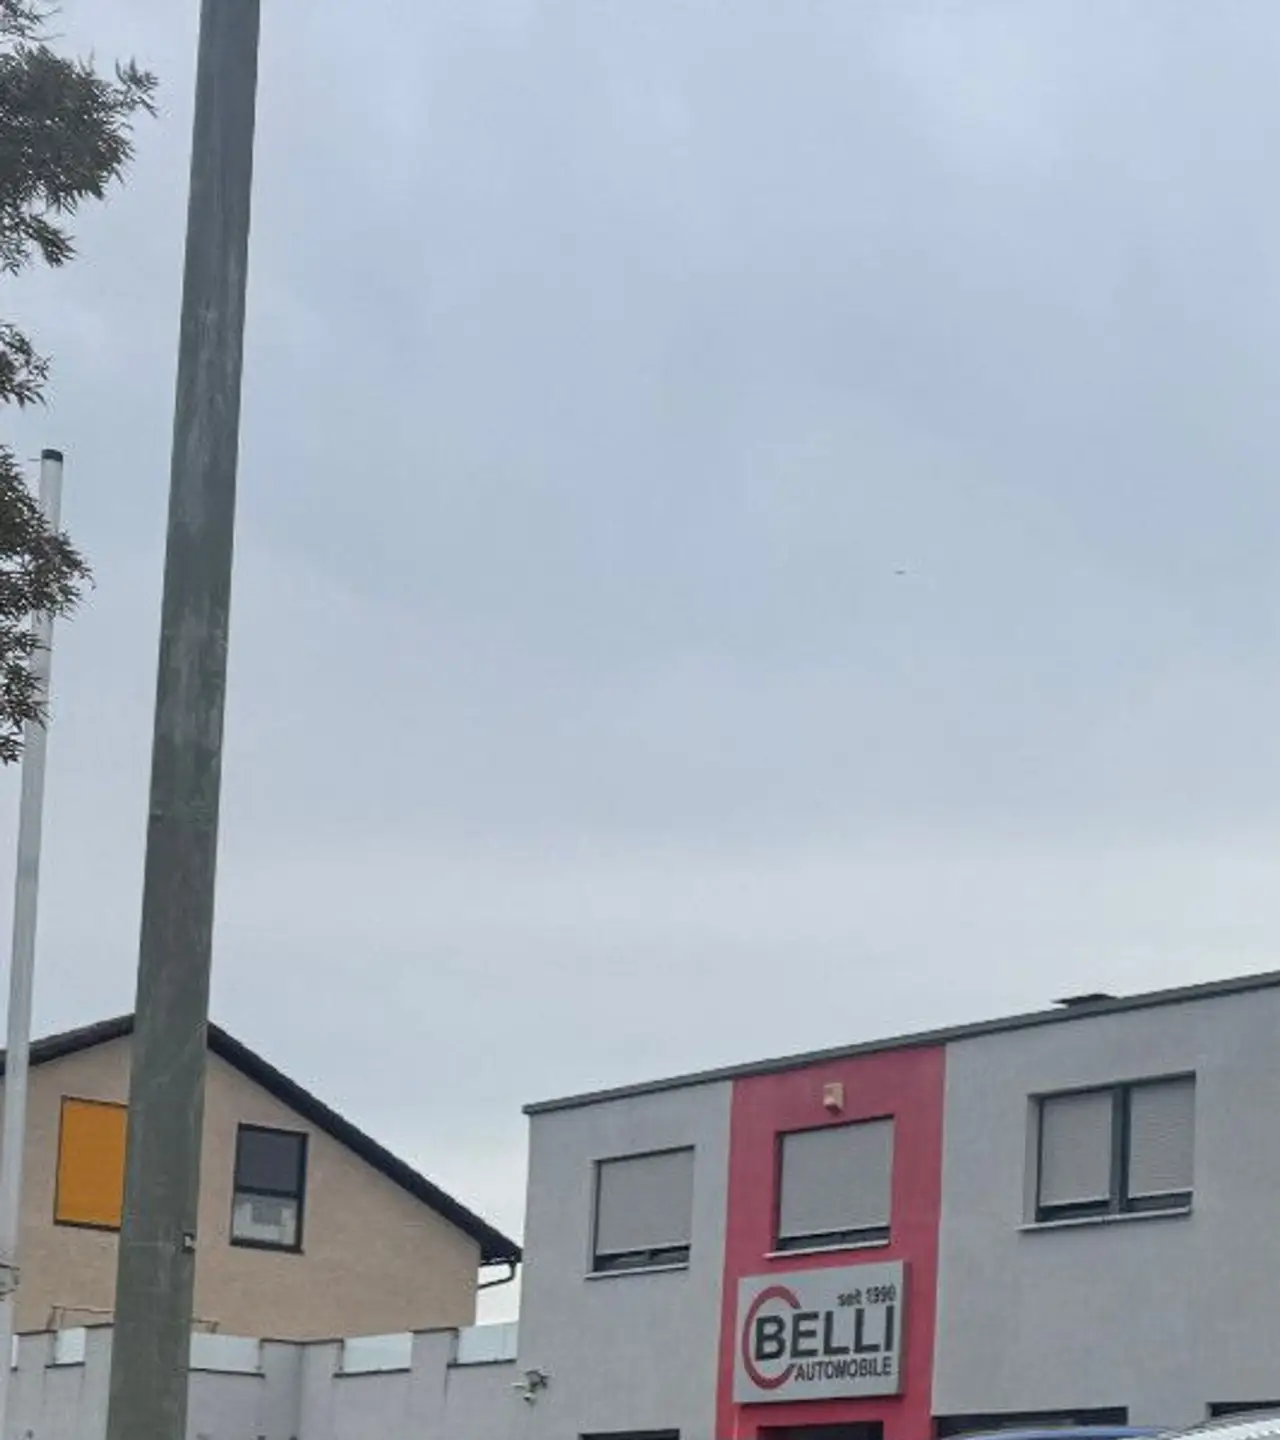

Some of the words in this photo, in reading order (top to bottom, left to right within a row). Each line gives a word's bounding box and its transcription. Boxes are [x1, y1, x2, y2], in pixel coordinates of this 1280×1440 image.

[836, 1288, 863, 1307] seit
[866, 1284, 896, 1305] 1990
[755, 1305, 895, 1361] BELLI
[794, 1356, 892, 1382] AUTOMOBILE
